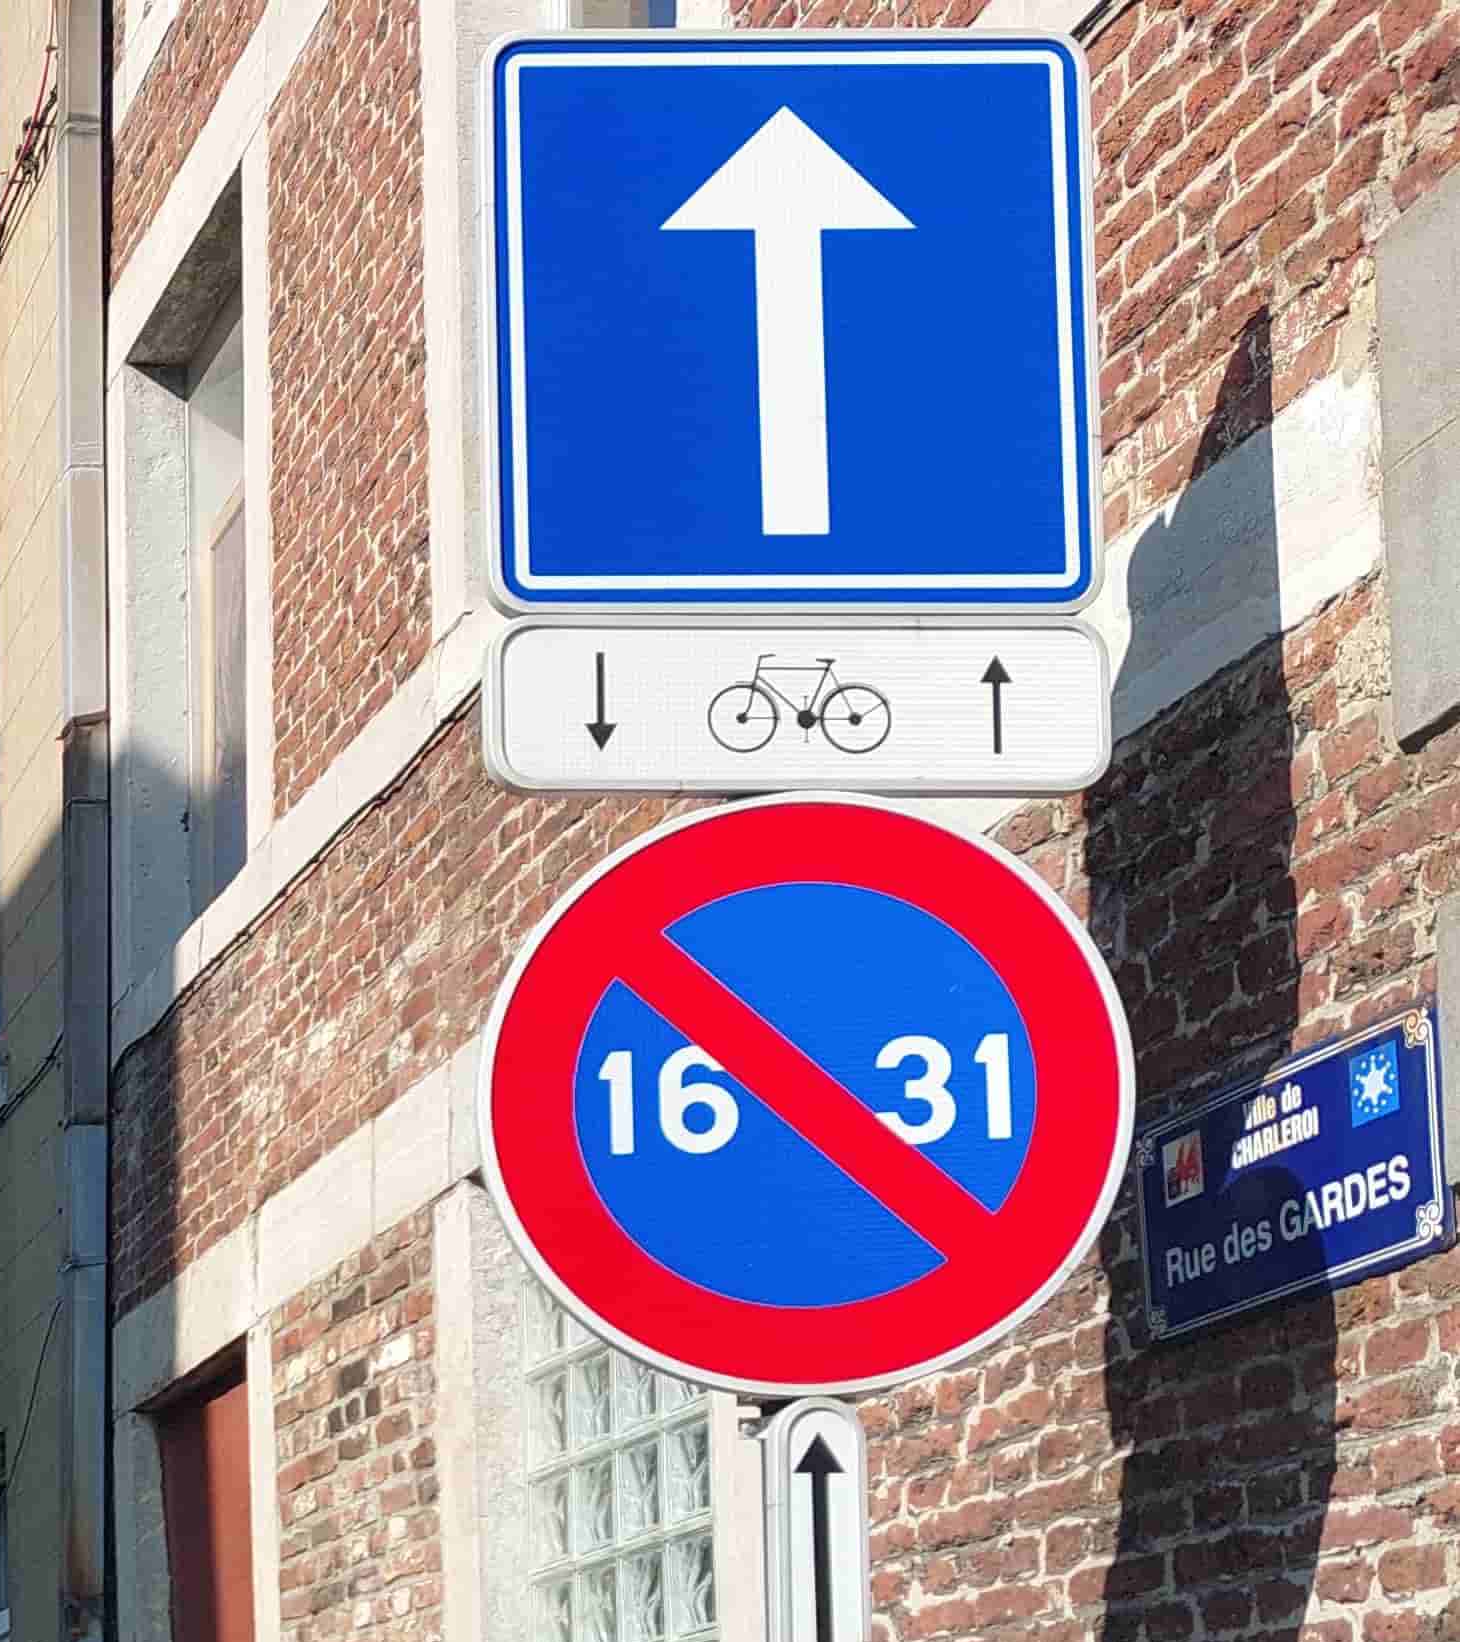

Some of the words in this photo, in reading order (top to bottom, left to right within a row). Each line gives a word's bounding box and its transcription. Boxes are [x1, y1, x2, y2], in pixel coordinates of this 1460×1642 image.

[598, 1044, 740, 1156] 16
[875, 1032, 1013, 1145] 31
[1231, 1105, 1320, 1169] CHARLEROI
[1242, 1094, 1278, 1131] Ville
[1281, 1081, 1302, 1113] de
[1165, 1242, 1217, 1289] Rue
[1223, 1220, 1273, 1265] des
[1279, 1154, 1412, 1241] GARDES
